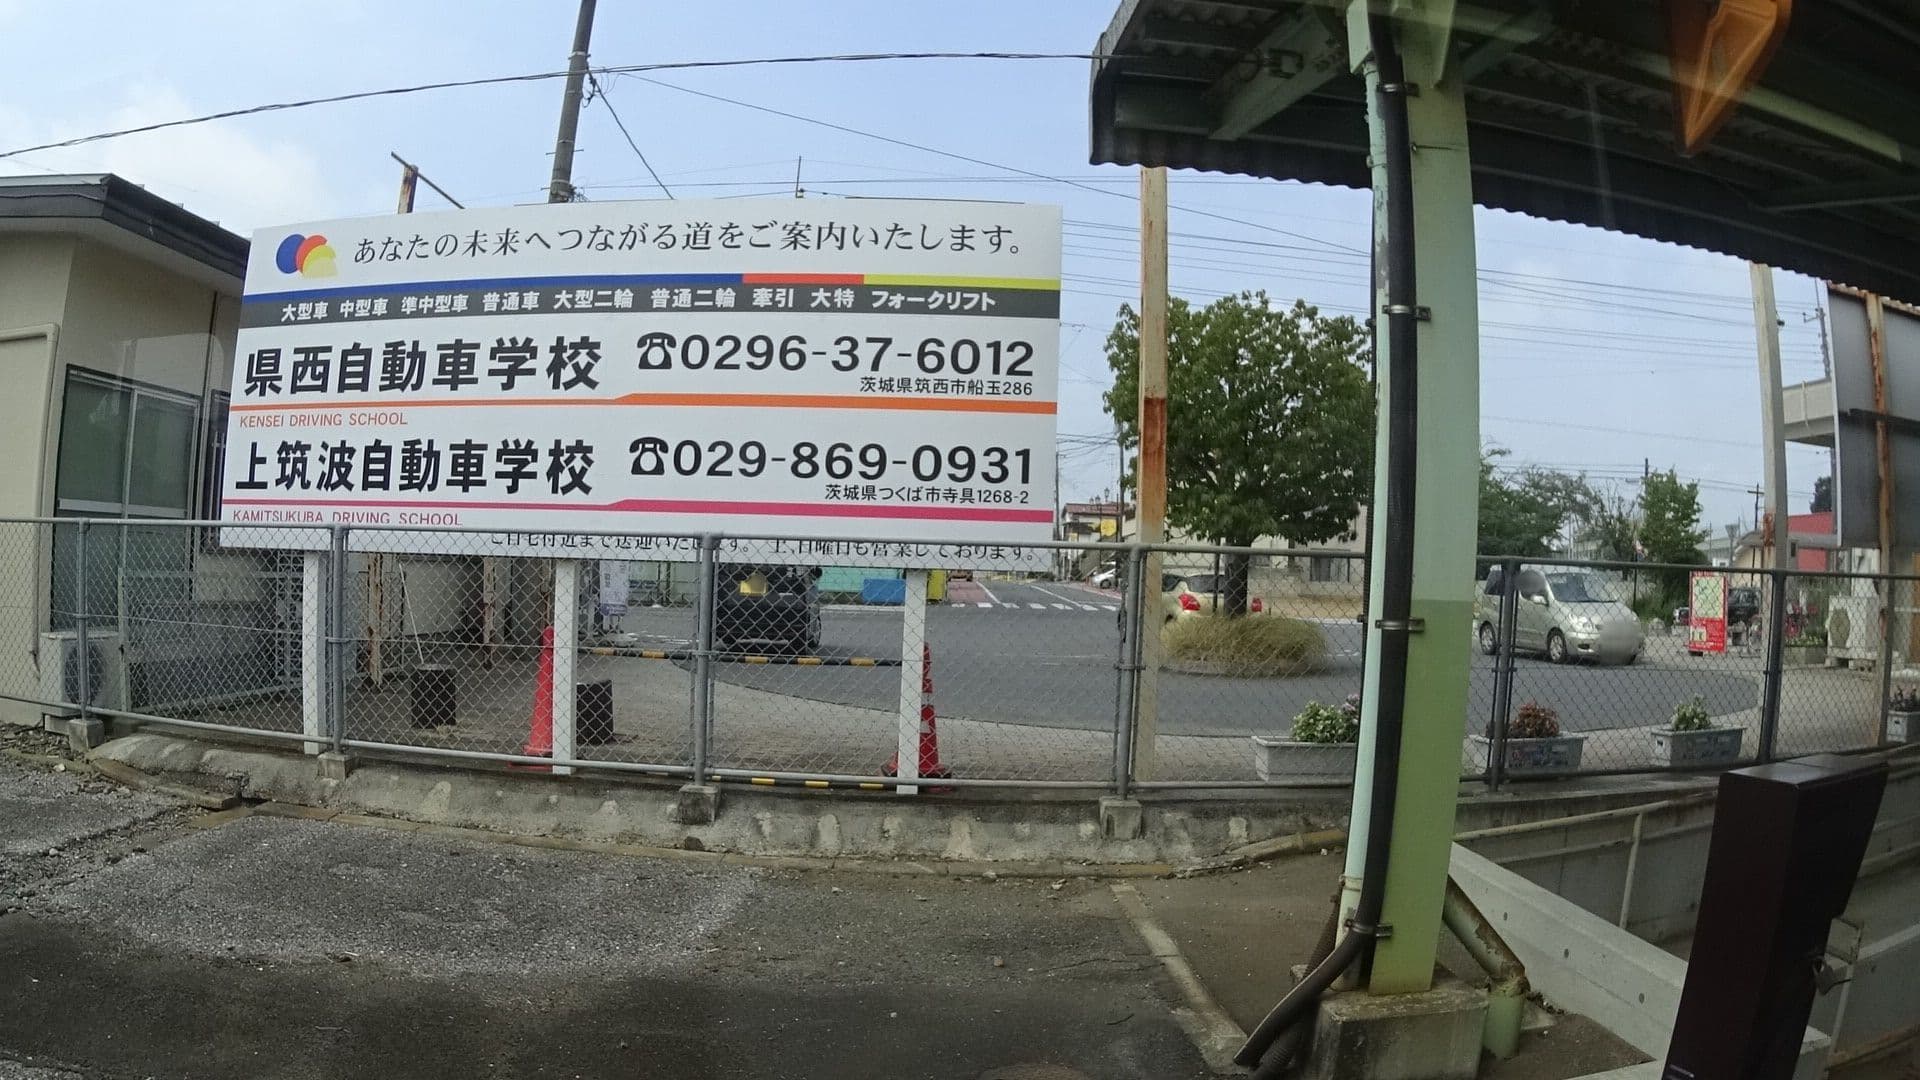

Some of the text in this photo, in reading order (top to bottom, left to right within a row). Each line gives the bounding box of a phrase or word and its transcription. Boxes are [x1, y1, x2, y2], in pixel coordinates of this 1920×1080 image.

[354, 219, 1021, 264] あなたの未来へつながる道をご案内いたします。
[281, 287, 996, 324] 大型車 中型車 準中型車 普通車 大型二輪 普通二輪 牽引 大特 フォークリフト
[244, 335, 602, 397] 県西自動車学校
[680, 334, 1034, 377] 0296-37-6012
[859, 377, 1033, 396] 茨城県筑西市船玉286
[239, 412, 409, 428] KENSEI DRIVING SCHOOL
[235, 439, 595, 495] 上筑波自動車学校
[673, 439, 1031, 484] 029-869-0931
[825, 484, 1029, 504] 茨城県つくば市寺具1268-2
[233, 510, 463, 526] KAMITSUKUBA DRIVING SCHOOL
